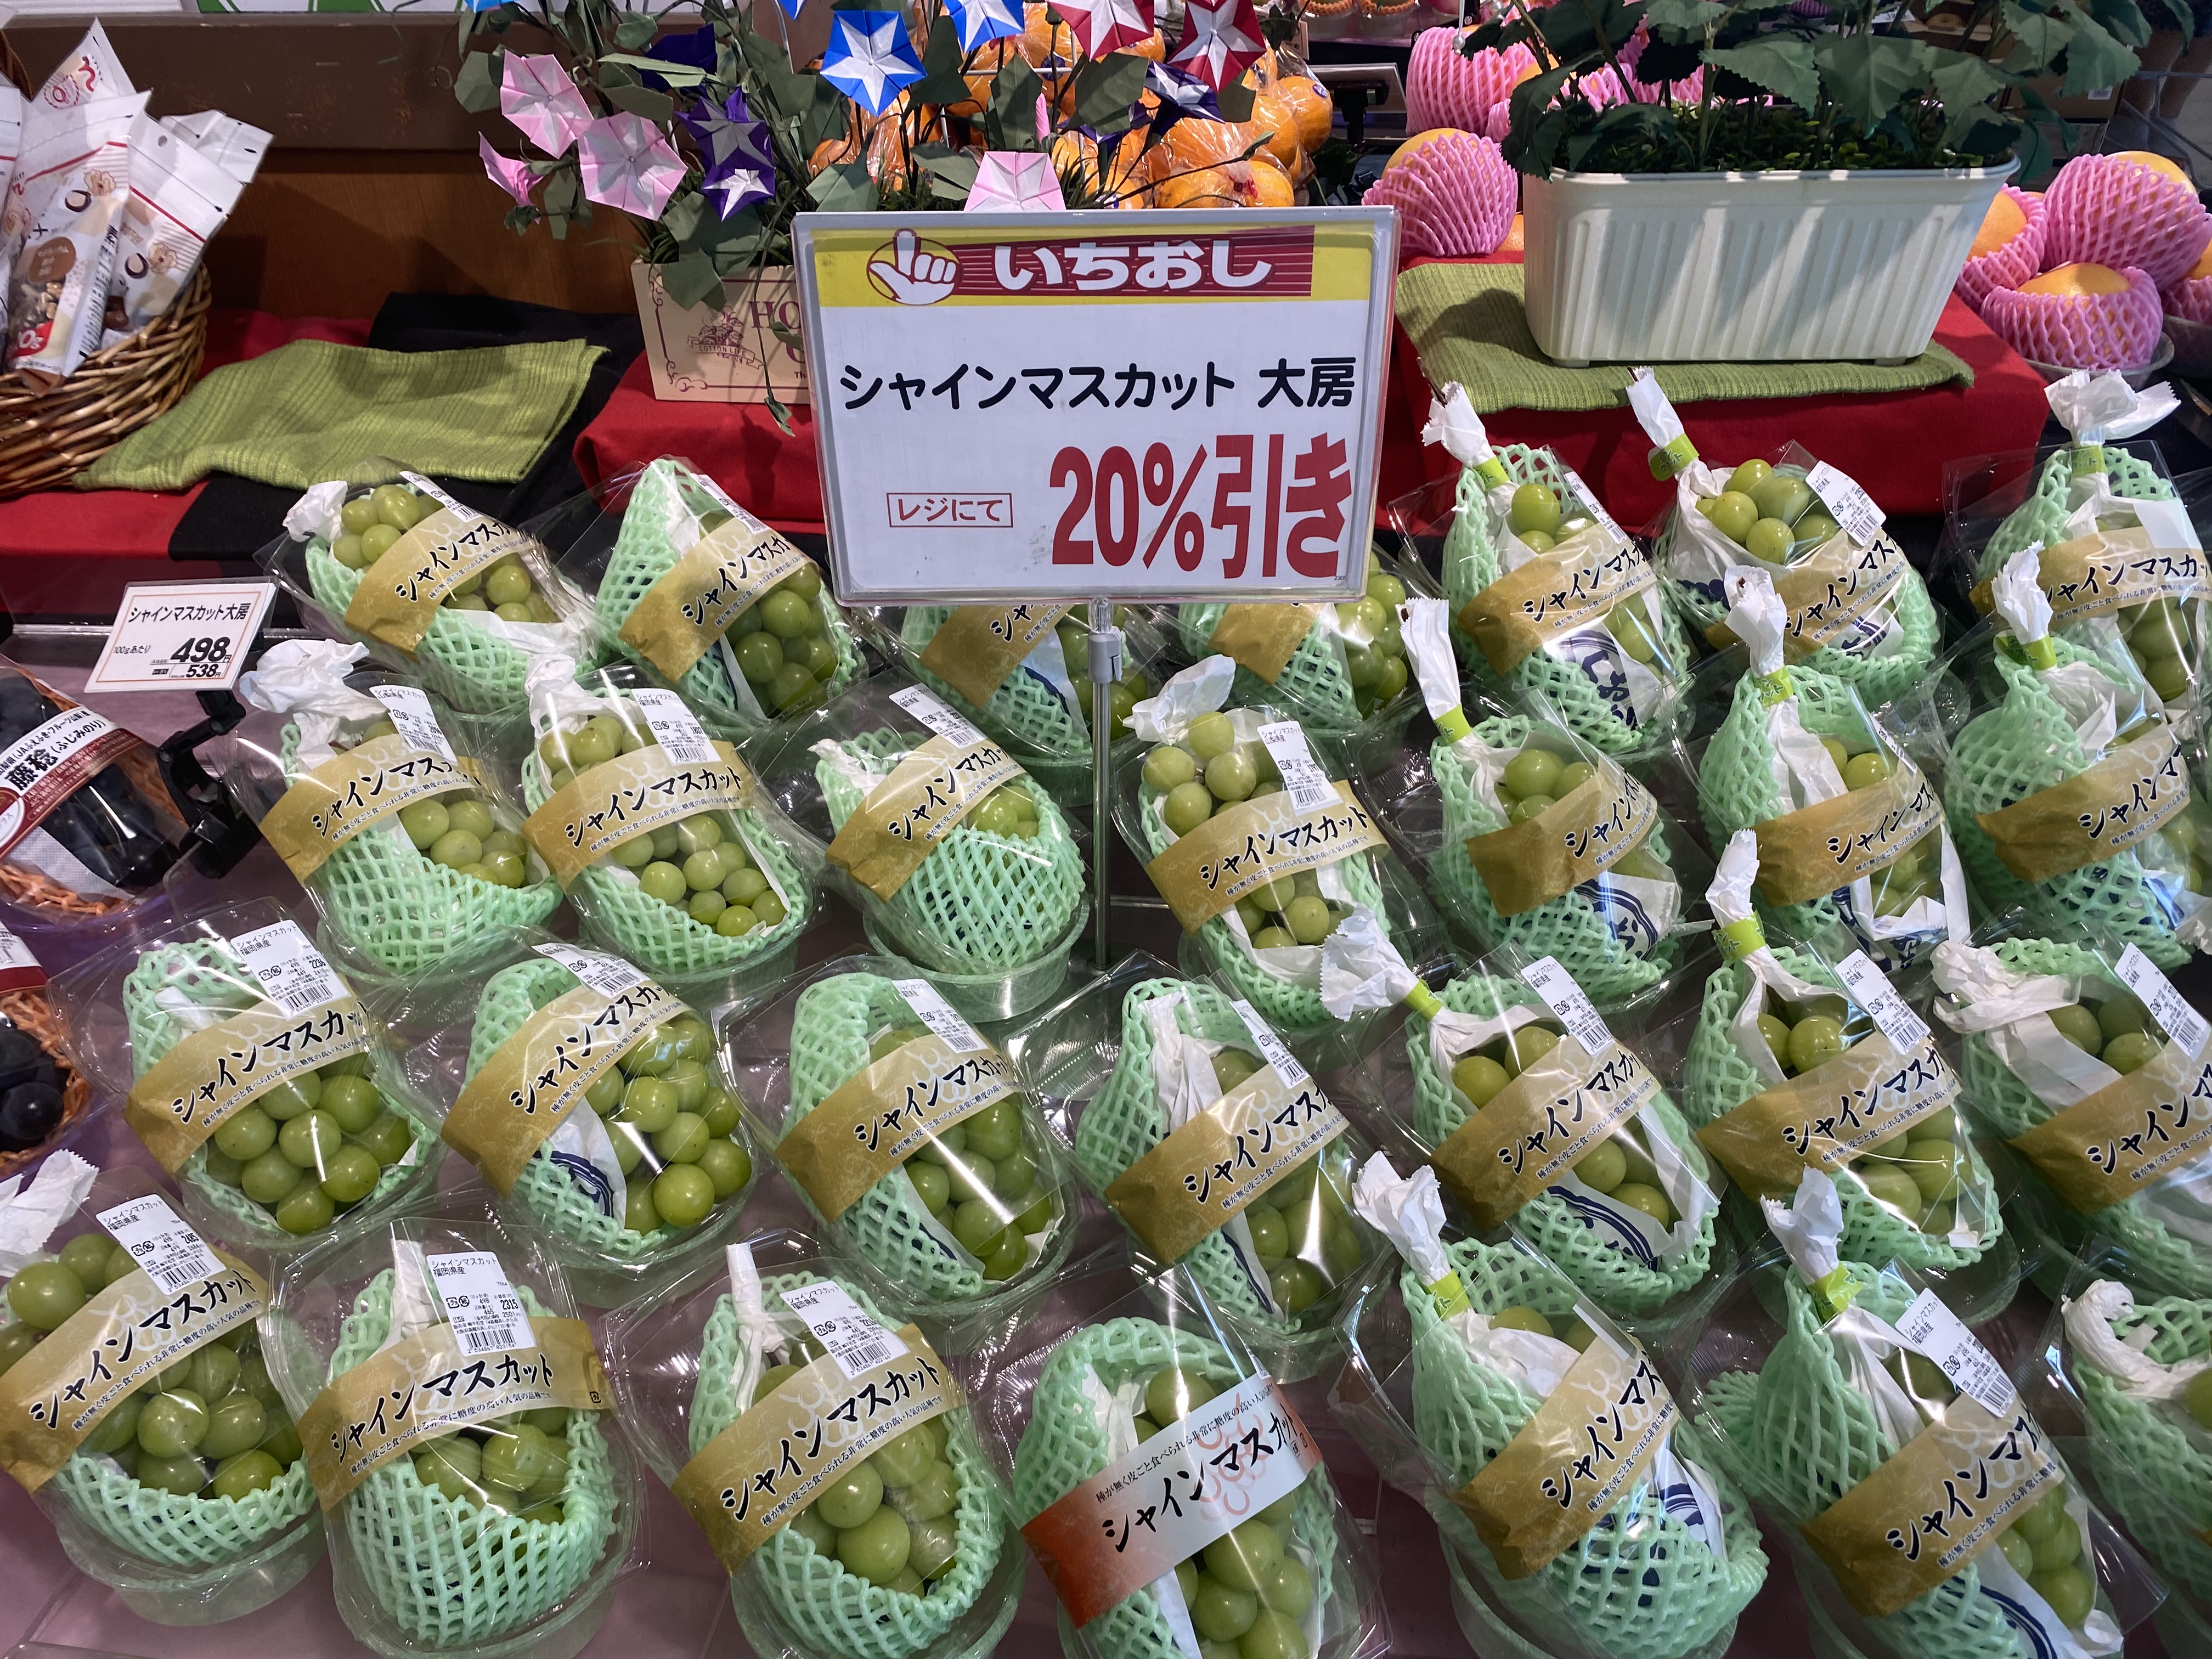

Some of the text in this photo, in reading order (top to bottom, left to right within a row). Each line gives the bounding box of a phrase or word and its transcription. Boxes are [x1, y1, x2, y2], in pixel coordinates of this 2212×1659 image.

[995, 240, 1274, 291] いちおし
[730, 347, 747, 357] LIFE
[840, 357, 1356, 410] シャインマスカット 大房
[896, 496, 1005, 522] レジにて
[1049, 432, 1352, 579] 20%引き
[128, 602, 251, 623] シャインマスカット大房
[170, 636, 230, 663] 498
[565, 765, 741, 848] シャインマスカット
[1200, 806, 1368, 889] シャインマスカット
[237, 924, 297, 949] シャインマスカット
[240, 940, 272, 956] 福岡県産
[309, 959, 326, 969] 2236
[103, 1200, 163, 1224] シャインマスカット
[108, 1214, 141, 1232] 福岡県産
[181, 1233, 200, 1244] 2485
[432, 1257, 498, 1268] シャインマスカット
[433, 1267, 466, 1277] 福岡県産
[500, 1299, 518, 1310] 2315
[787, 1285, 840, 1303] シャインマスカット
[791, 1297, 820, 1310] 福岡県産
[29, 1269, 258, 1430] シャインマスカット
[329, 1352, 554, 1465] シャインマスカット
[720, 1356, 940, 1522] シャインマスカット
[1541, 1350, 1662, 1509] シャインマス
[1102, 1401, 1299, 1553] シャインマスカット
